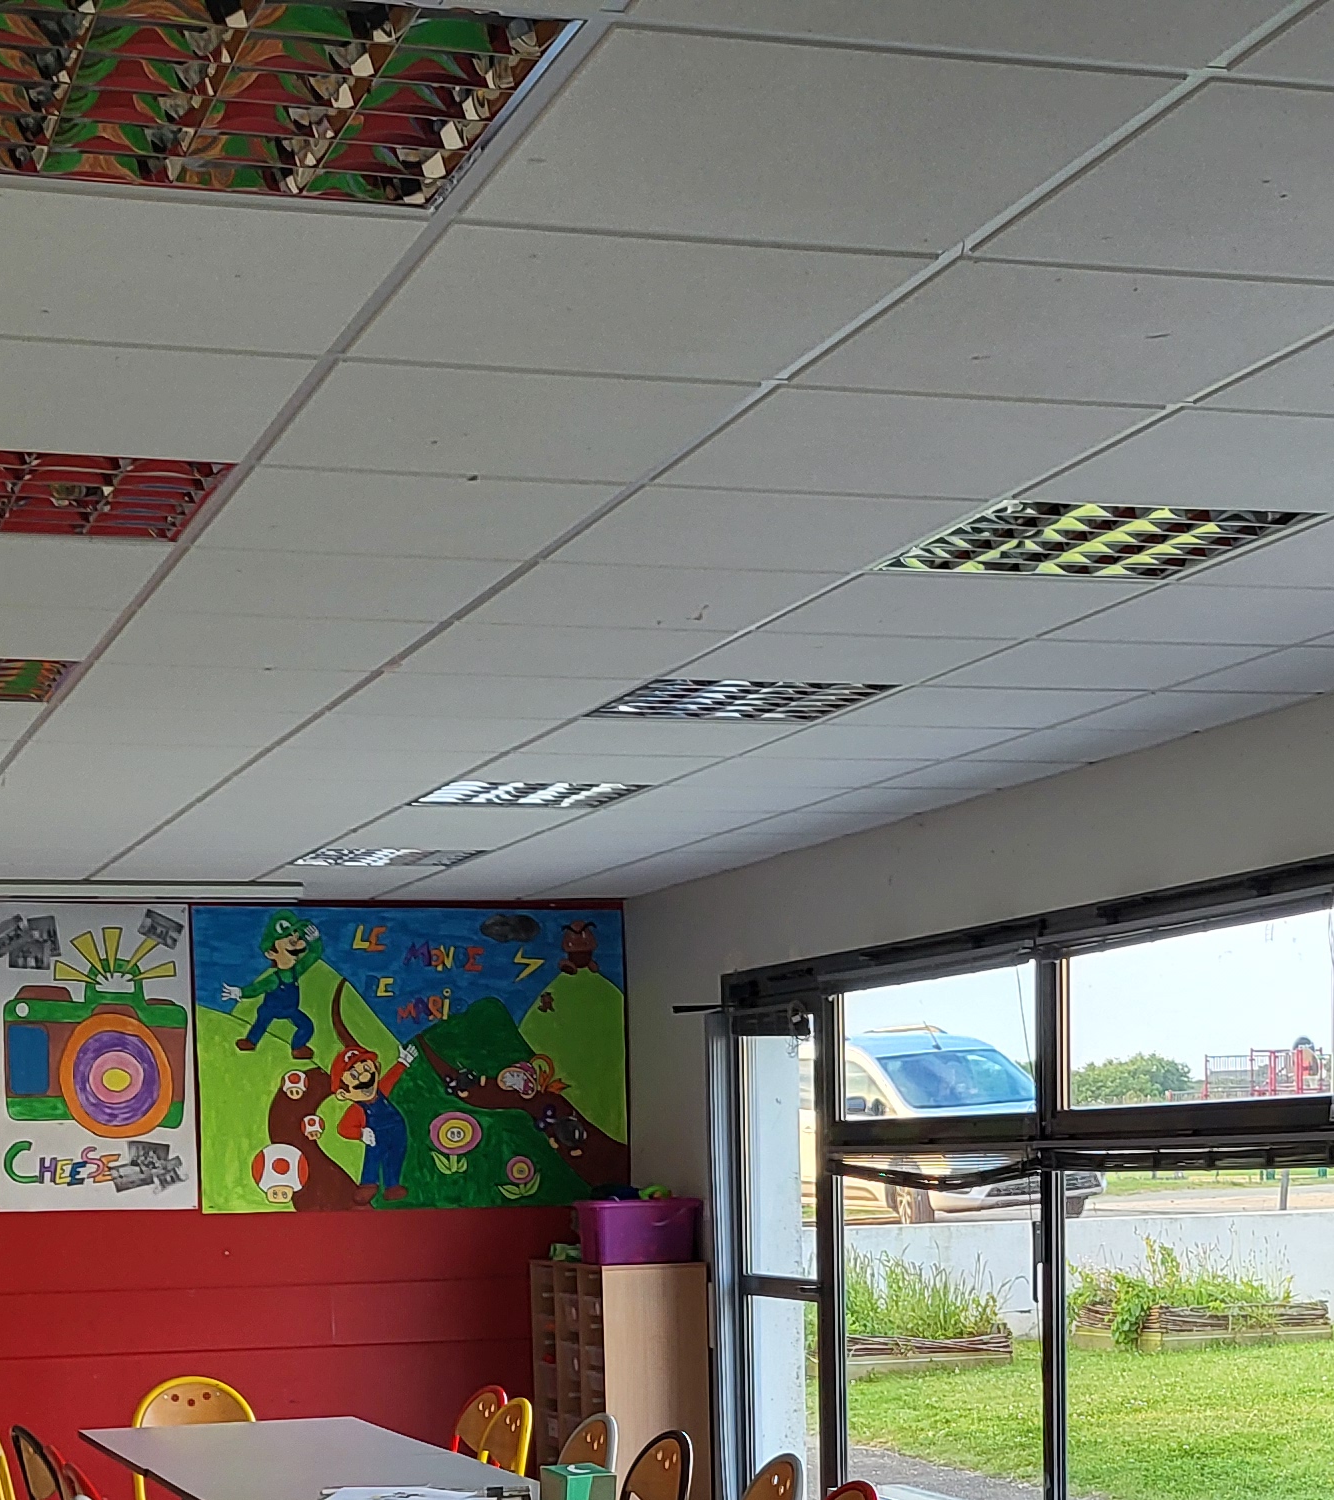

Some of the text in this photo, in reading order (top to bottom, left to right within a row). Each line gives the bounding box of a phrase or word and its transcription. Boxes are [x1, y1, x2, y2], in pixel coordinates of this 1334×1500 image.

[352, 924, 387, 952] LE
[403, 941, 485, 972] MONDE
[365, 974, 395, 997] DE
[3, 1140, 122, 1187] CHEESE
